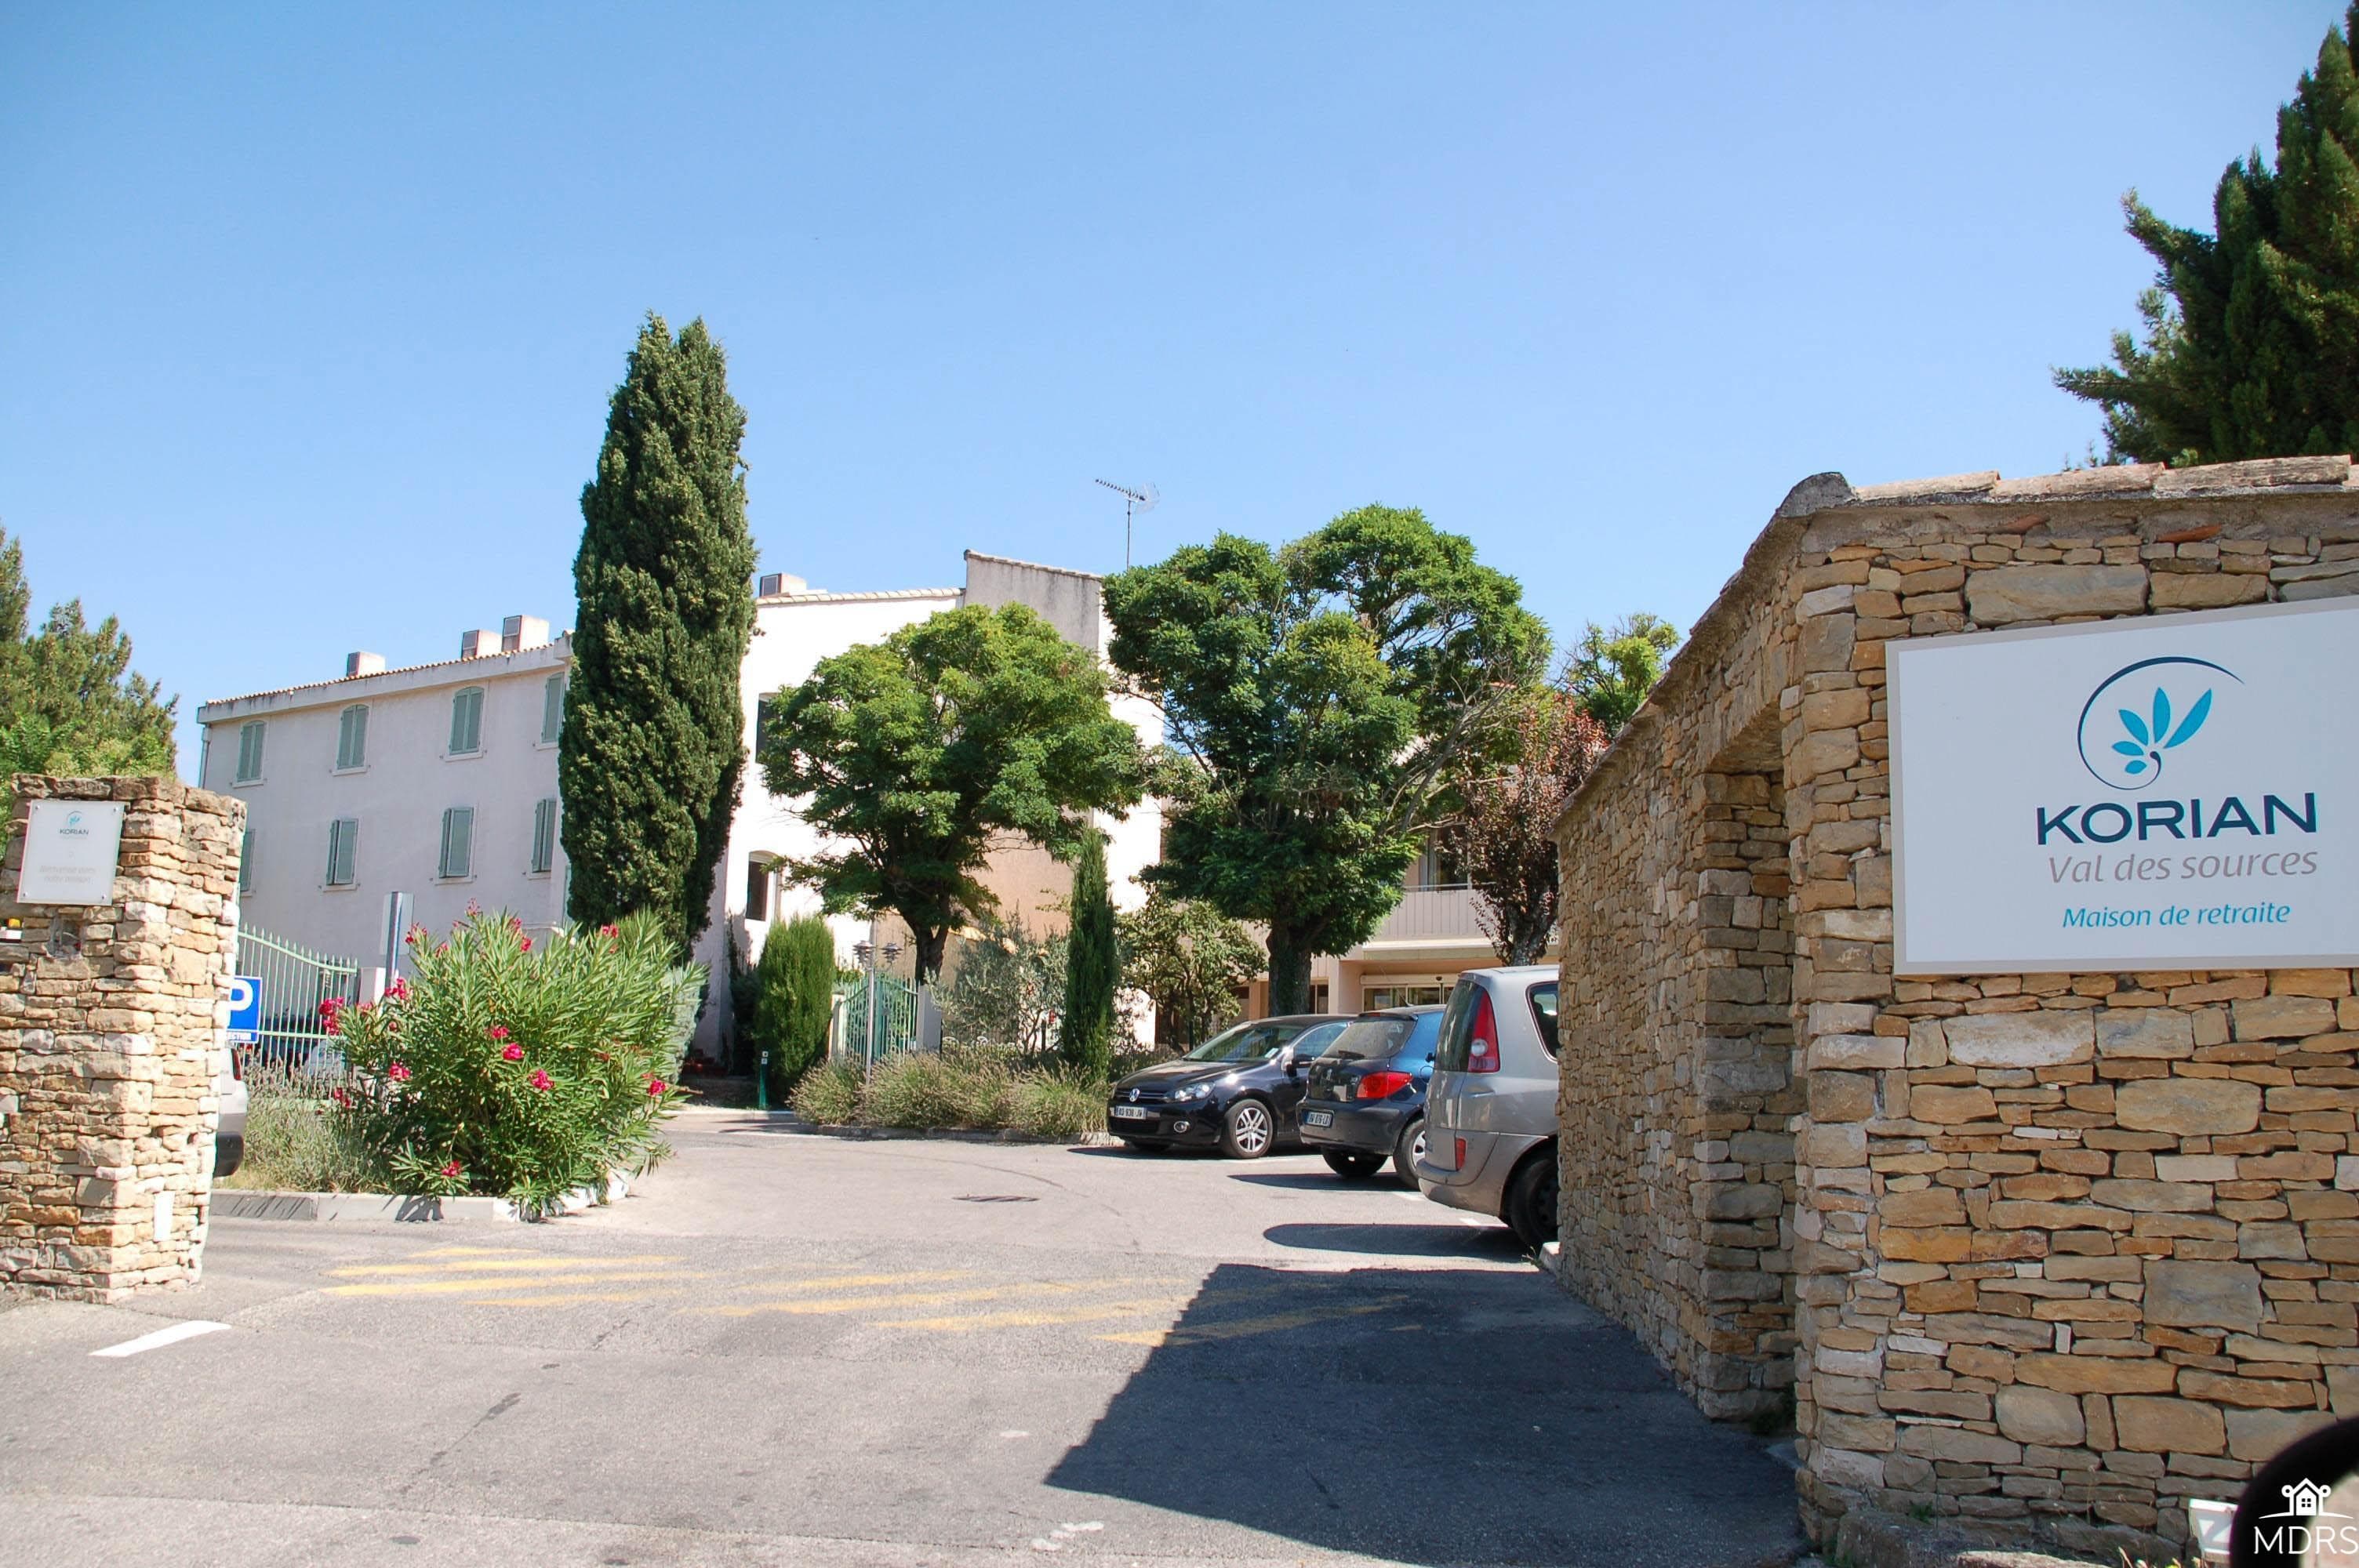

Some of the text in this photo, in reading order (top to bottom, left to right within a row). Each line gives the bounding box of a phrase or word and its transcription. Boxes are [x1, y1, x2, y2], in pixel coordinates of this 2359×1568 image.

[2036, 792, 2317, 845] KORIAN
[2048, 851, 2318, 883] Val des sources
[2062, 902, 2292, 928] Maison de retraite
